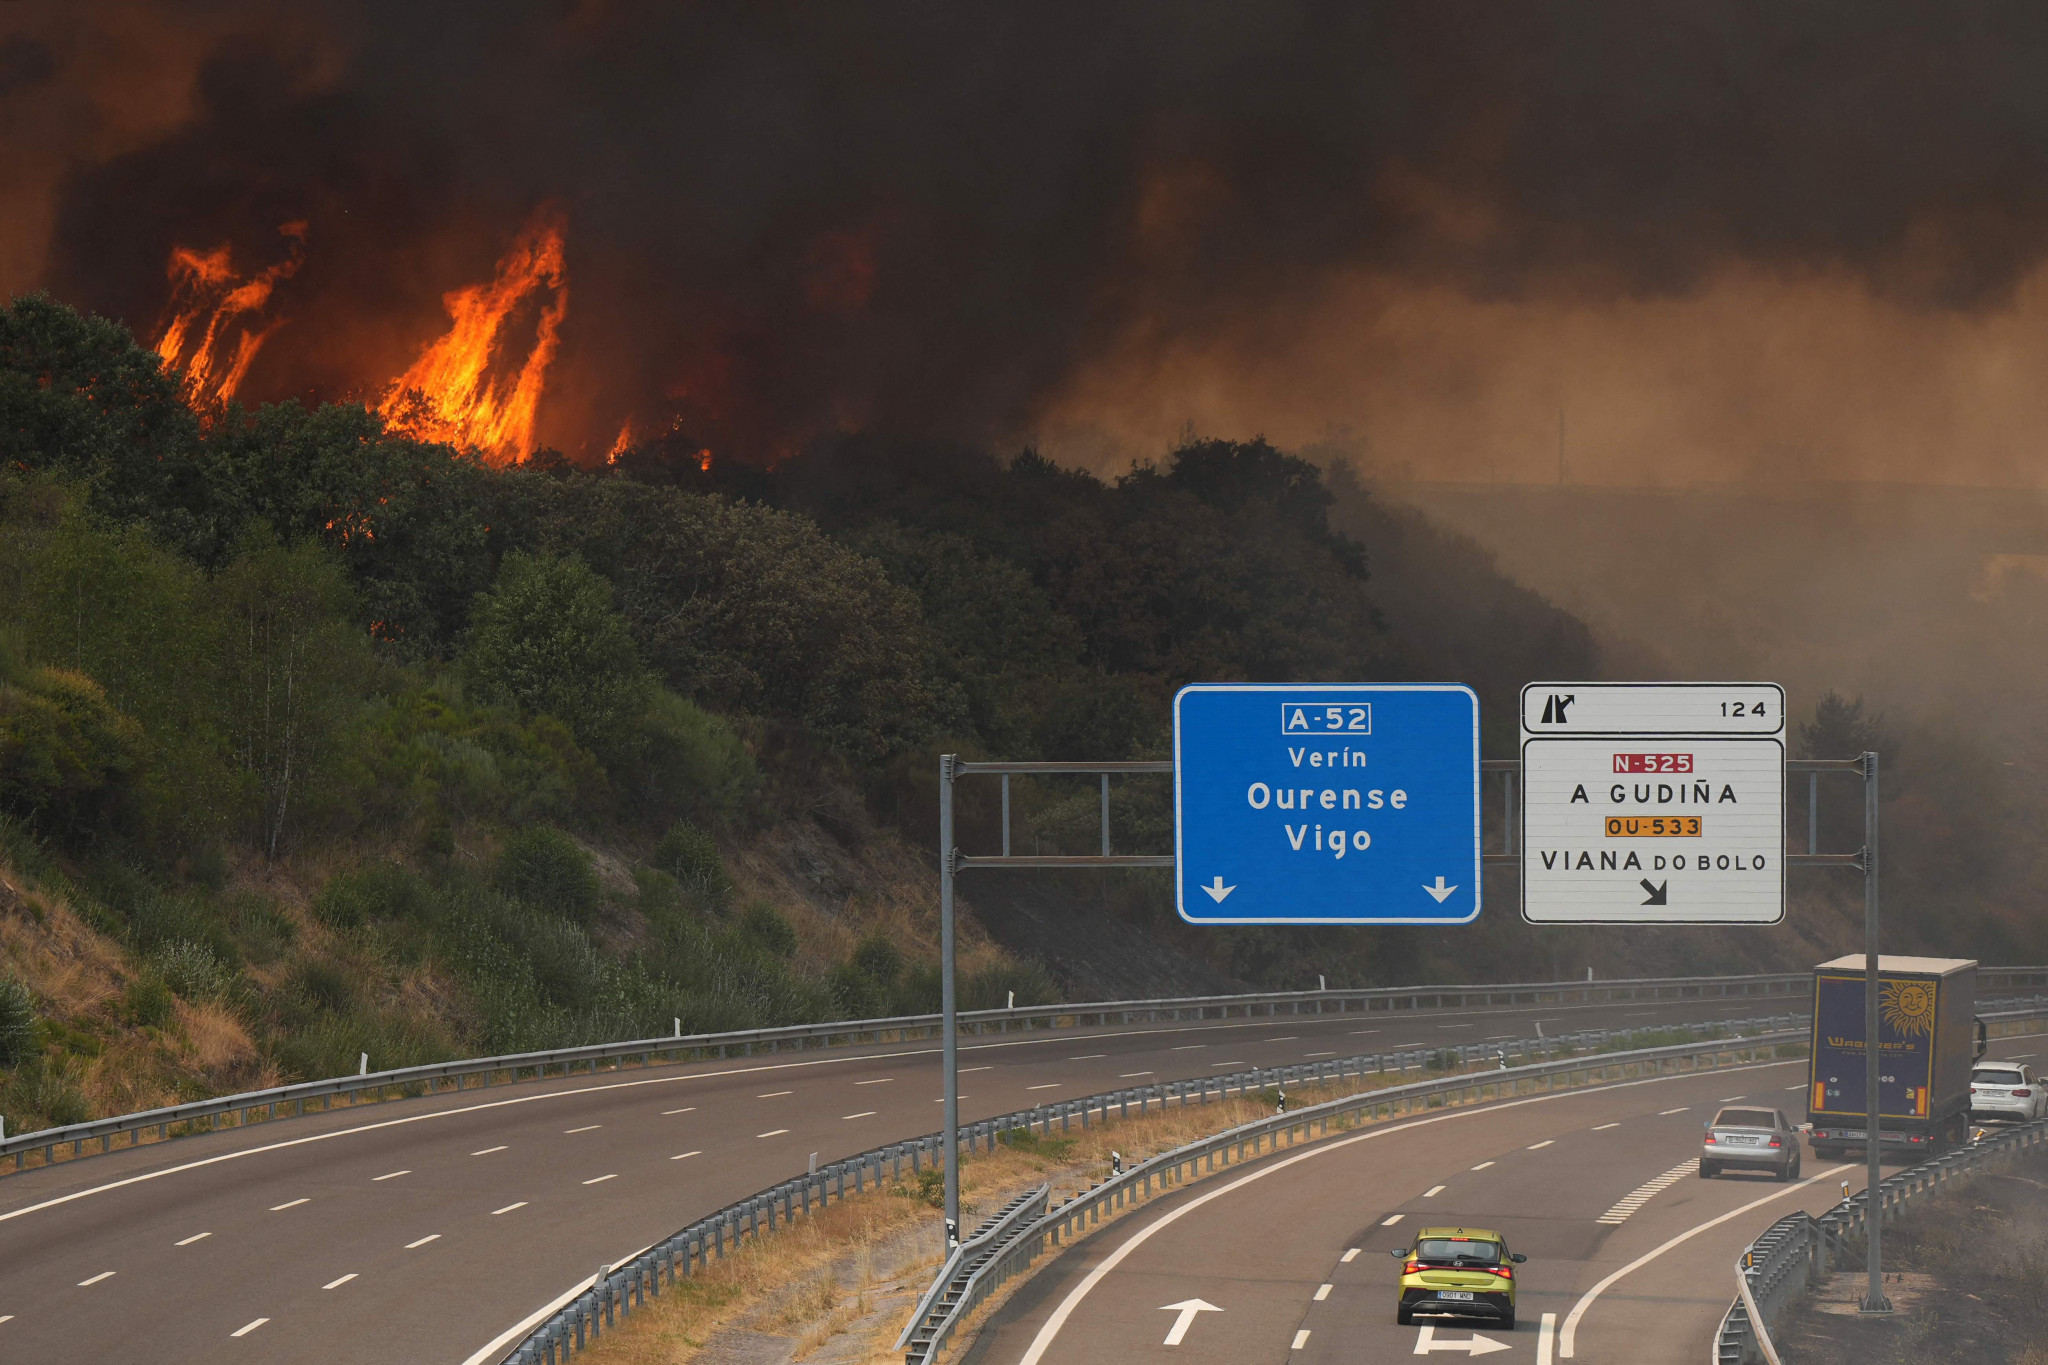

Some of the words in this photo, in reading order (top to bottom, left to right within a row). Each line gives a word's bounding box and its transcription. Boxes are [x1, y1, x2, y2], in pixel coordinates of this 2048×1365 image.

[1288, 708, 1366, 729] A-52
[1721, 702, 1766, 717] 124
[1288, 746, 1367, 767] Verín
[1615, 755, 1691, 772] N-525
[1248, 782, 1408, 809] Ourense
[1570, 784, 1590, 804] A
[1610, 780, 1737, 804] GUDIÑA
[1608, 819, 1699, 835] OU-533
[1284, 824, 1371, 859] Vigo
[1541, 851, 1642, 870] VIANA
[1654, 855, 1686, 870] DO
[1698, 855, 1766, 870] BOLO
